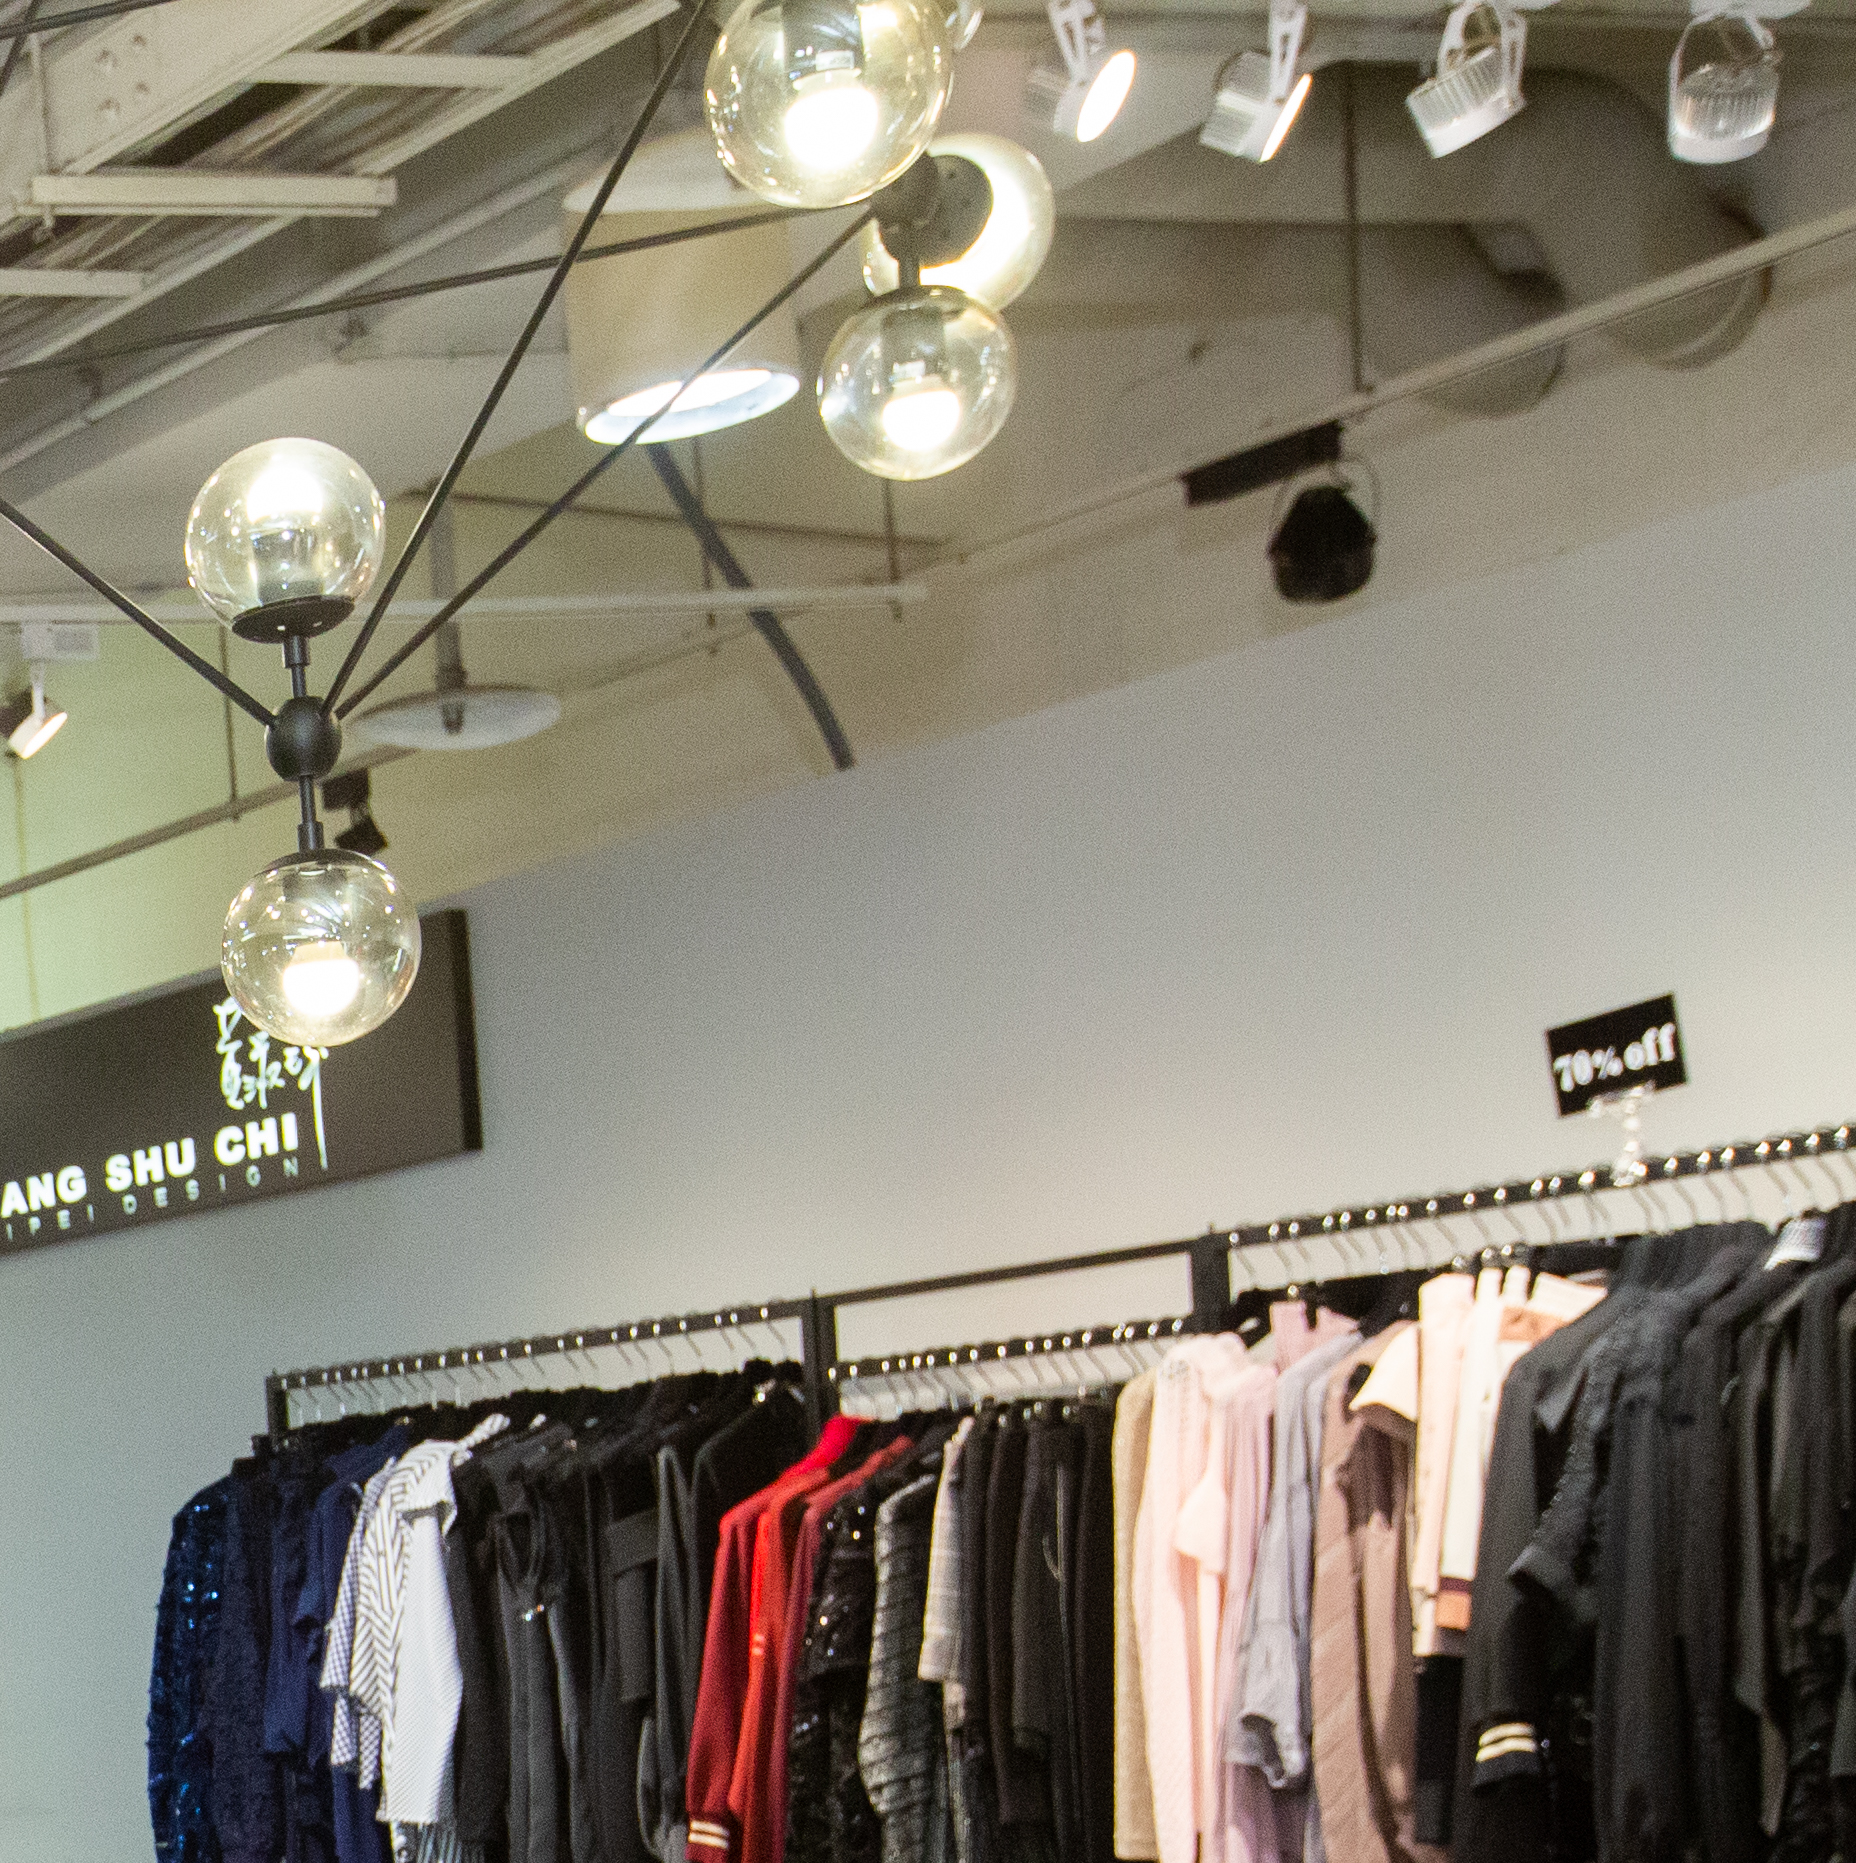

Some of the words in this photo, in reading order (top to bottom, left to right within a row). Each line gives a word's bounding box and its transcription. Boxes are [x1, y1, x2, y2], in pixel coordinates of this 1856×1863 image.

[104, 1136, 197, 1193] SHU
[213, 1112, 299, 1168] CHI
[121, 1155, 300, 1216] DESIGN
